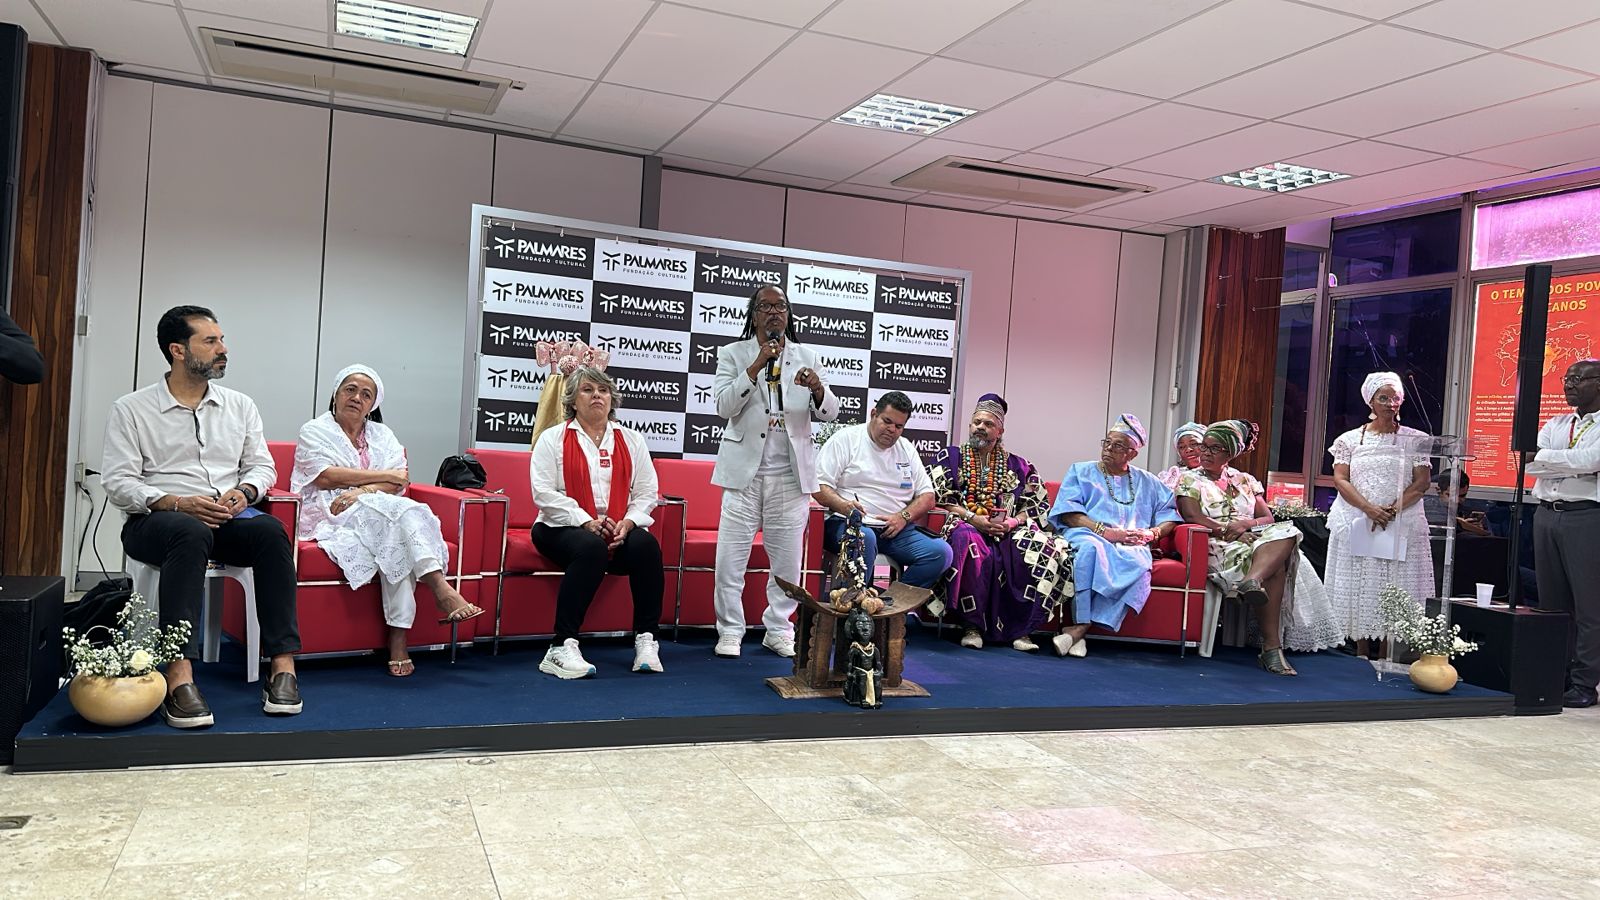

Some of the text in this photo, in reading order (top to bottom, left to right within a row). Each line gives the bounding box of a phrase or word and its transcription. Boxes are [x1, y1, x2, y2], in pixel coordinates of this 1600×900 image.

[517, 239, 587, 261] PALMARES
[517, 255, 586, 268] FUNDAÇÃO CULTURAL
[623, 253, 687, 273] PALMARES
[622, 268, 687, 280] FUNDAÇÃO CULTURAL
[721, 265, 781, 285] PALMARES
[515, 282, 584, 303] PALMARES
[813, 276, 869, 294] PALMARES
[1490, 290, 1499, 300] O
[1502, 287, 1524, 299] TEM
[812, 290, 840, 298] FUNDAÇÃO
[898, 286, 952, 304] PALMARES
[514, 298, 584, 310] FUNDAÇÃO CULTURAL
[621, 294, 685, 314] PALMARES
[620, 309, 652, 317] FUNDAÇÃO
[719, 306, 747, 320] PALM
[810, 315, 866, 334] PALMARES
[896, 325, 949, 342] PALMARES
[619, 336, 683, 354] PALMARES
[821, 356, 864, 371] LMARES
[893, 362, 947, 379] PALMARES
[511, 369, 546, 384] PALM
[616, 377, 680, 395] PALMARES
[617, 420, 677, 435] ALMARES
